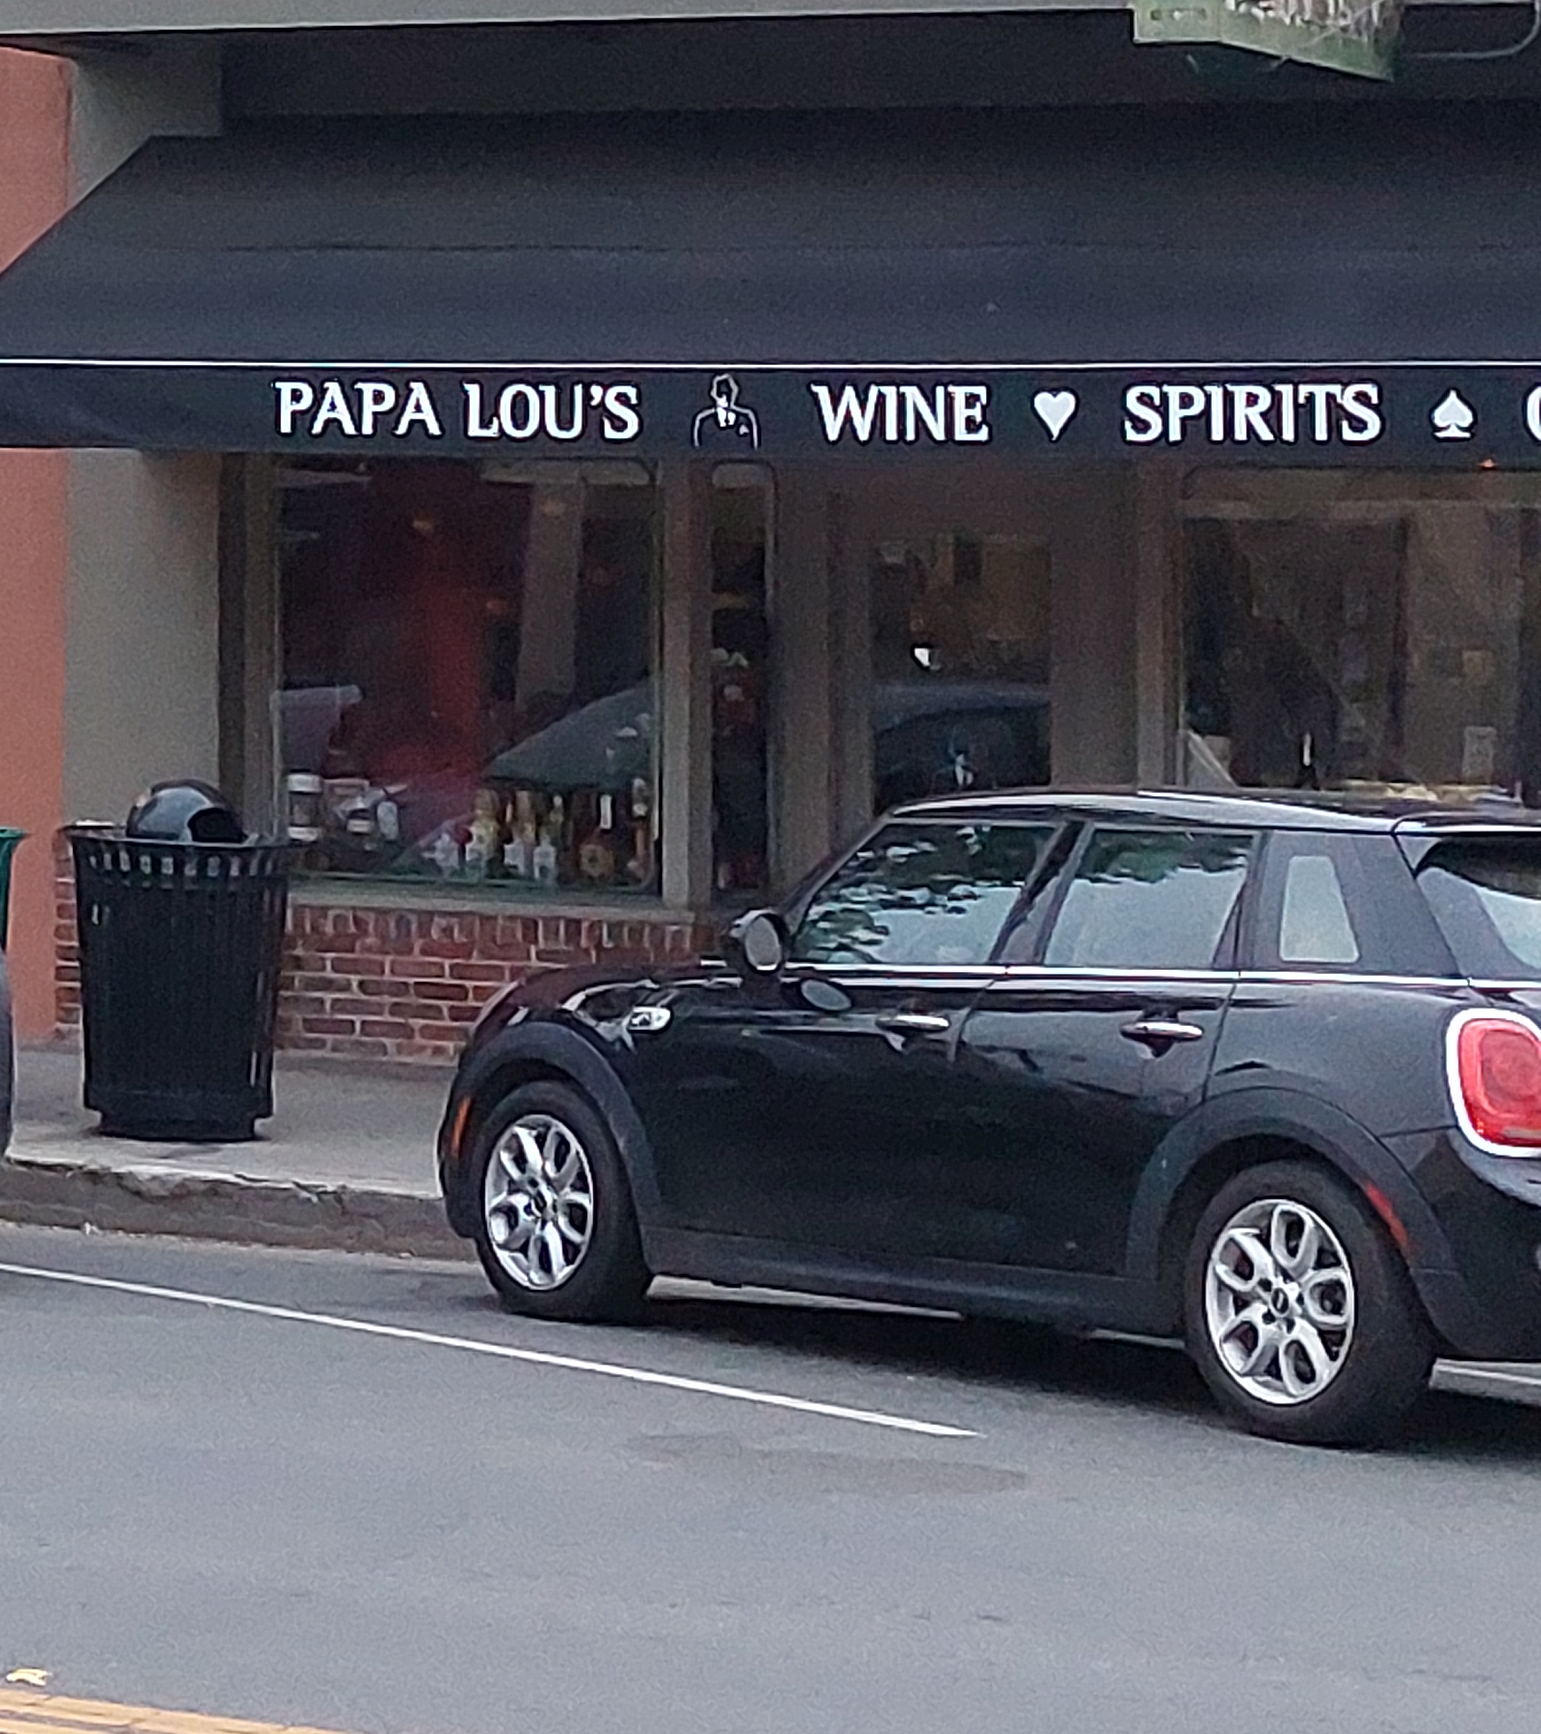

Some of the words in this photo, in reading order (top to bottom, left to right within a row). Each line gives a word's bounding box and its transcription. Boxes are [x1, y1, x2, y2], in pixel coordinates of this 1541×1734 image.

[270, 381, 443, 435] PAPA
[461, 382, 640, 440] LOU'S
[810, 383, 989, 442] WINE
[1123, 383, 1381, 443] SPIRITS
